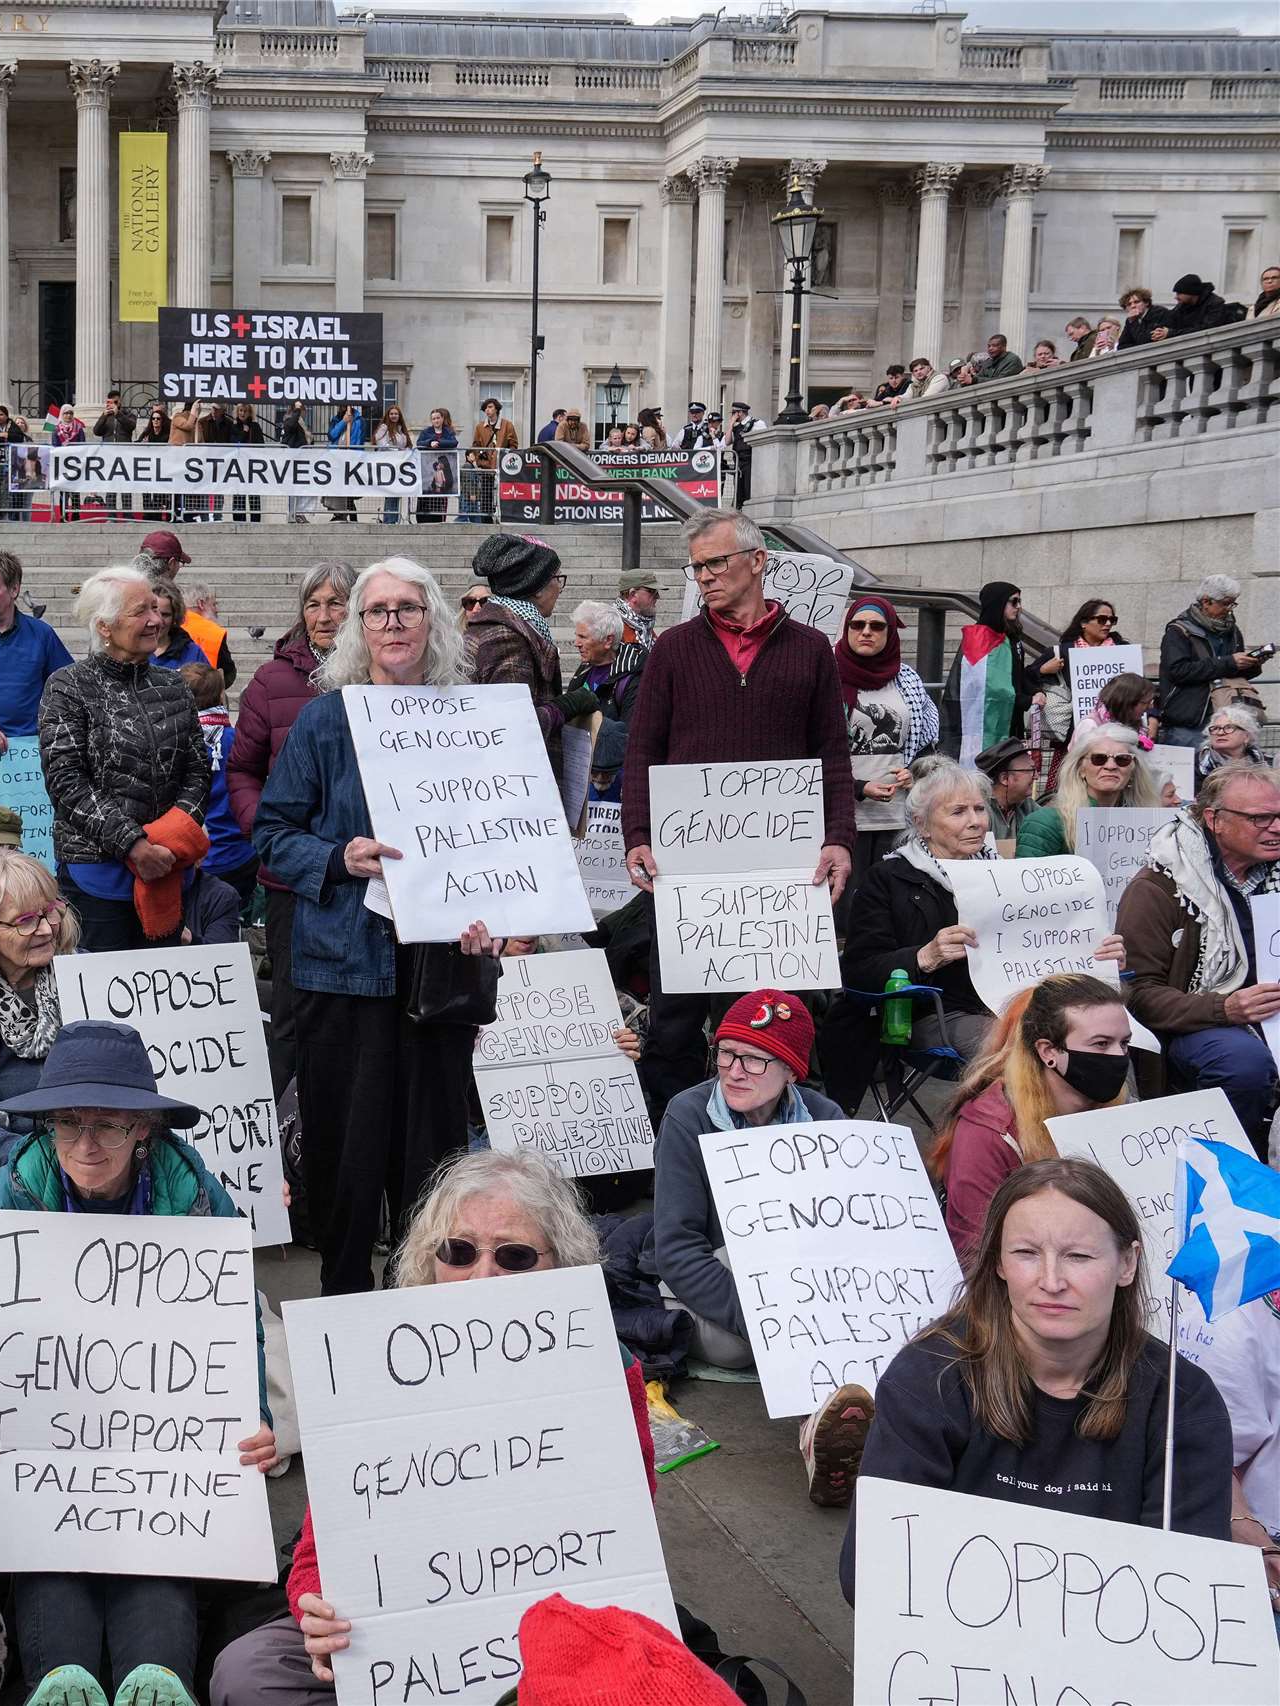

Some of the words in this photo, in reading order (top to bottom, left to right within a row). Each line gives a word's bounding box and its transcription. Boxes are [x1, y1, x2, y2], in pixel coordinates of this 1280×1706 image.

[131, 163, 144, 252] NATIONAL
[145, 165, 160, 253] GALLERY
[183, 343, 247, 368] HERE
[255, 345, 286, 369] TO
[293, 347, 358, 371] KILL
[53, 455, 174, 482] ISRAEL
[183, 457, 333, 485] STARVES
[343, 460, 418, 487] KIDS
[640, 452, 689, 464] DEMAND
[1076, 666, 1080, 676] I
[1082, 663, 1126, 676] OPPOSE
[363, 695, 372, 723] I
[390, 696, 476, 716] OPPOSE
[379, 728, 507, 753] GENOCIDE
[388, 782, 401, 812] I
[416, 775, 539, 804] SUPPORT
[700, 768, 714, 797] I
[720, 765, 824, 797] OPPOSE
[588, 805, 620, 821] TIRED
[659, 809, 816, 848] GENOCIDE
[1084, 821, 1090, 846] I
[1097, 822, 1154, 844] OPPOSE
[444, 865, 539, 903] ACTION
[988, 870, 1001, 897] I
[1020, 867, 1085, 893] OPPOSE
[673, 886, 689, 922] I
[700, 883, 816, 918] SUPPORT
[1001, 897, 1095, 923] GENOCIDE
[676, 914, 833, 955] PALESTINE
[996, 932, 1003, 953] I
[1022, 927, 1096, 950] SUPPORT
[518, 959, 531, 988] I
[703, 951, 822, 986] ACTION
[1002, 955, 1095, 983] PALESTINE
[78, 972, 90, 1020] I
[107, 964, 238, 1019] OPPOSE
[496, 984, 596, 1021] PPOSE
[146, 1030, 250, 1080] OCIDE
[479, 1018, 621, 1061] GENOCIDE
[545, 1062, 555, 1085] I
[488, 1073, 635, 1119] SUPPORT
[512, 1114, 653, 1152] PALESTINE
[548, 1147, 634, 1176] TION
[716, 1143, 760, 1184] I
[769, 1133, 918, 1175] OPPOSE
[1087, 1142, 1104, 1169] I
[725, 1193, 939, 1238] GENOCIDE
[74, 1238, 250, 1308] OPPOSE
[748, 1271, 778, 1311] I
[790, 1266, 935, 1305] SUPPORT
[324, 1332, 337, 1395] I
[386, 1307, 596, 1387] OPPOSE
[810, 1355, 885, 1402] ACT
[50, 1409, 242, 1455] SUPPORT
[14, 1462, 242, 1498] PALESTINE
[352, 1426, 565, 1520] GENOCIDE
[1017, 1479, 1040, 1491] your
[1044, 1484, 1063, 1495] dog
[1066, 1483, 1072, 1493] i
[1074, 1482, 1099, 1492] said
[1102, 1482, 1113, 1492] hi
[54, 1503, 211, 1538] ACTION
[374, 1553, 384, 1608] I
[425, 1528, 617, 1605] SUPPORT
[892, 1514, 924, 1618] I
[946, 1534, 1258, 1667] OPPOSE
[369, 1633, 520, 1706] PALES
